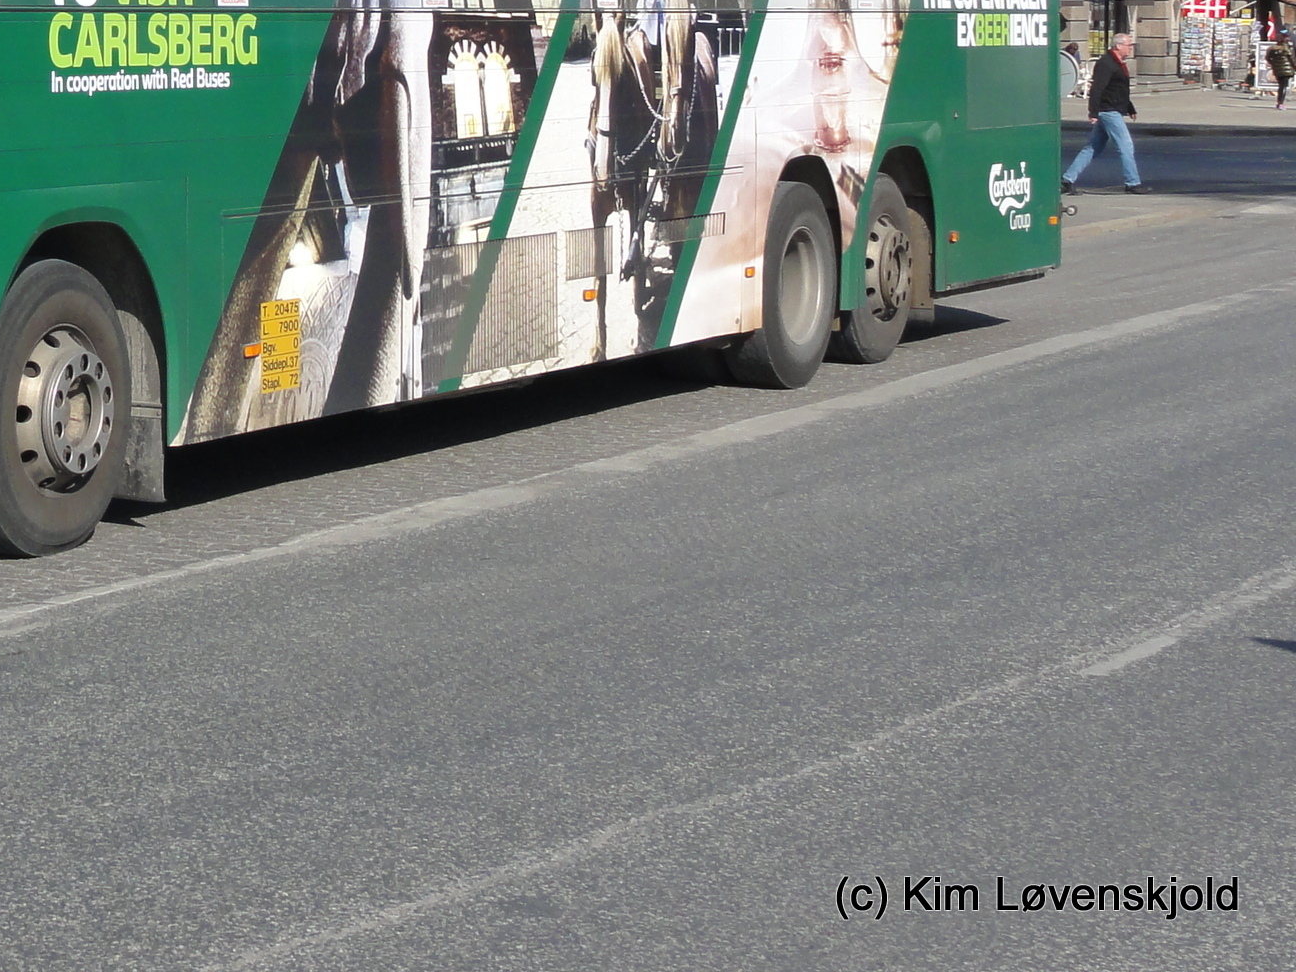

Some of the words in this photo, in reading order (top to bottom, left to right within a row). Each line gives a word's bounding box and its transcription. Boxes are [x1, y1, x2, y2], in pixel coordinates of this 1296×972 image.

[49, 13, 258, 68] CARLSBERG
[957, 13, 1048, 47] EXBEERIENCE
[51, 71, 63, 93] In
[67, 69, 139, 96] cooperation
[142, 68, 167, 90] with
[171, 67, 194, 89] Red
[197, 67, 230, 89] Buses
[988, 161, 1031, 216] Carlsberg
[1010, 210, 1031, 232] Group
[279, 319, 299, 333] 7900
[293, 337, 299, 348] 0
[289, 373, 299, 385] 72
